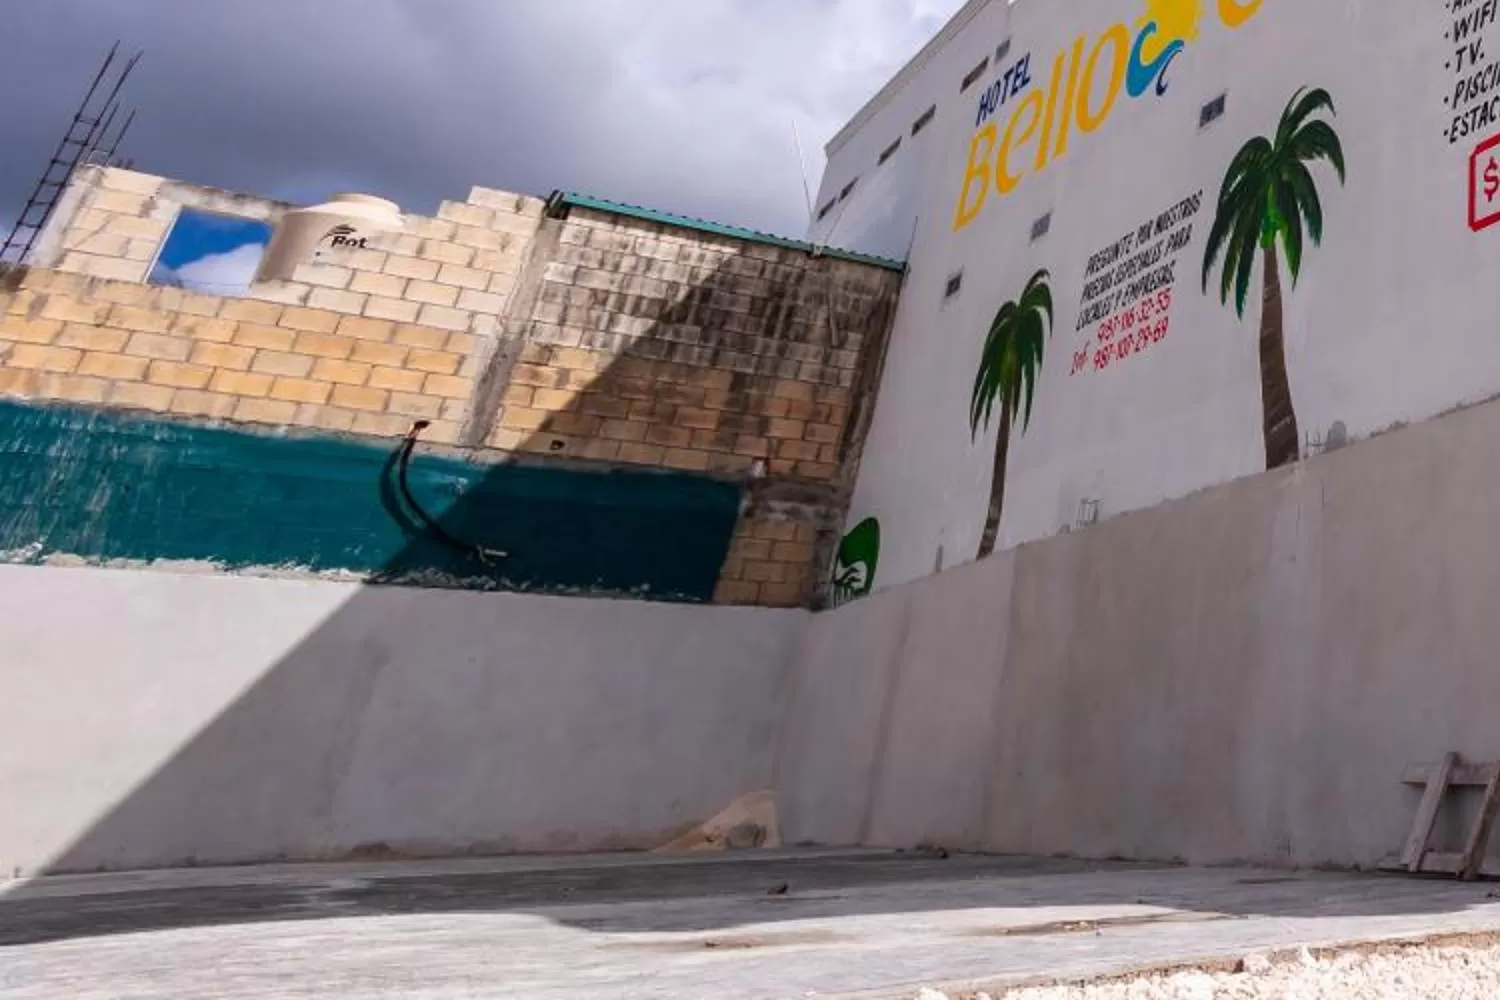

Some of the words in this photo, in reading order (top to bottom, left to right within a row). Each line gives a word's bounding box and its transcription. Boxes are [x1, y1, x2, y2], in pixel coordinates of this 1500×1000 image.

[975, 52, 1031, 127] HOTEL
[953, 23, 1130, 232] Bello
[1084, 231, 1135, 279] PREGUNTE
[1136, 219, 1154, 248] POR
[1154, 188, 1203, 236] NUESTROS
[1164, 223, 1192, 257] PARA
[1121, 260, 1176, 307] EMPRESAS
